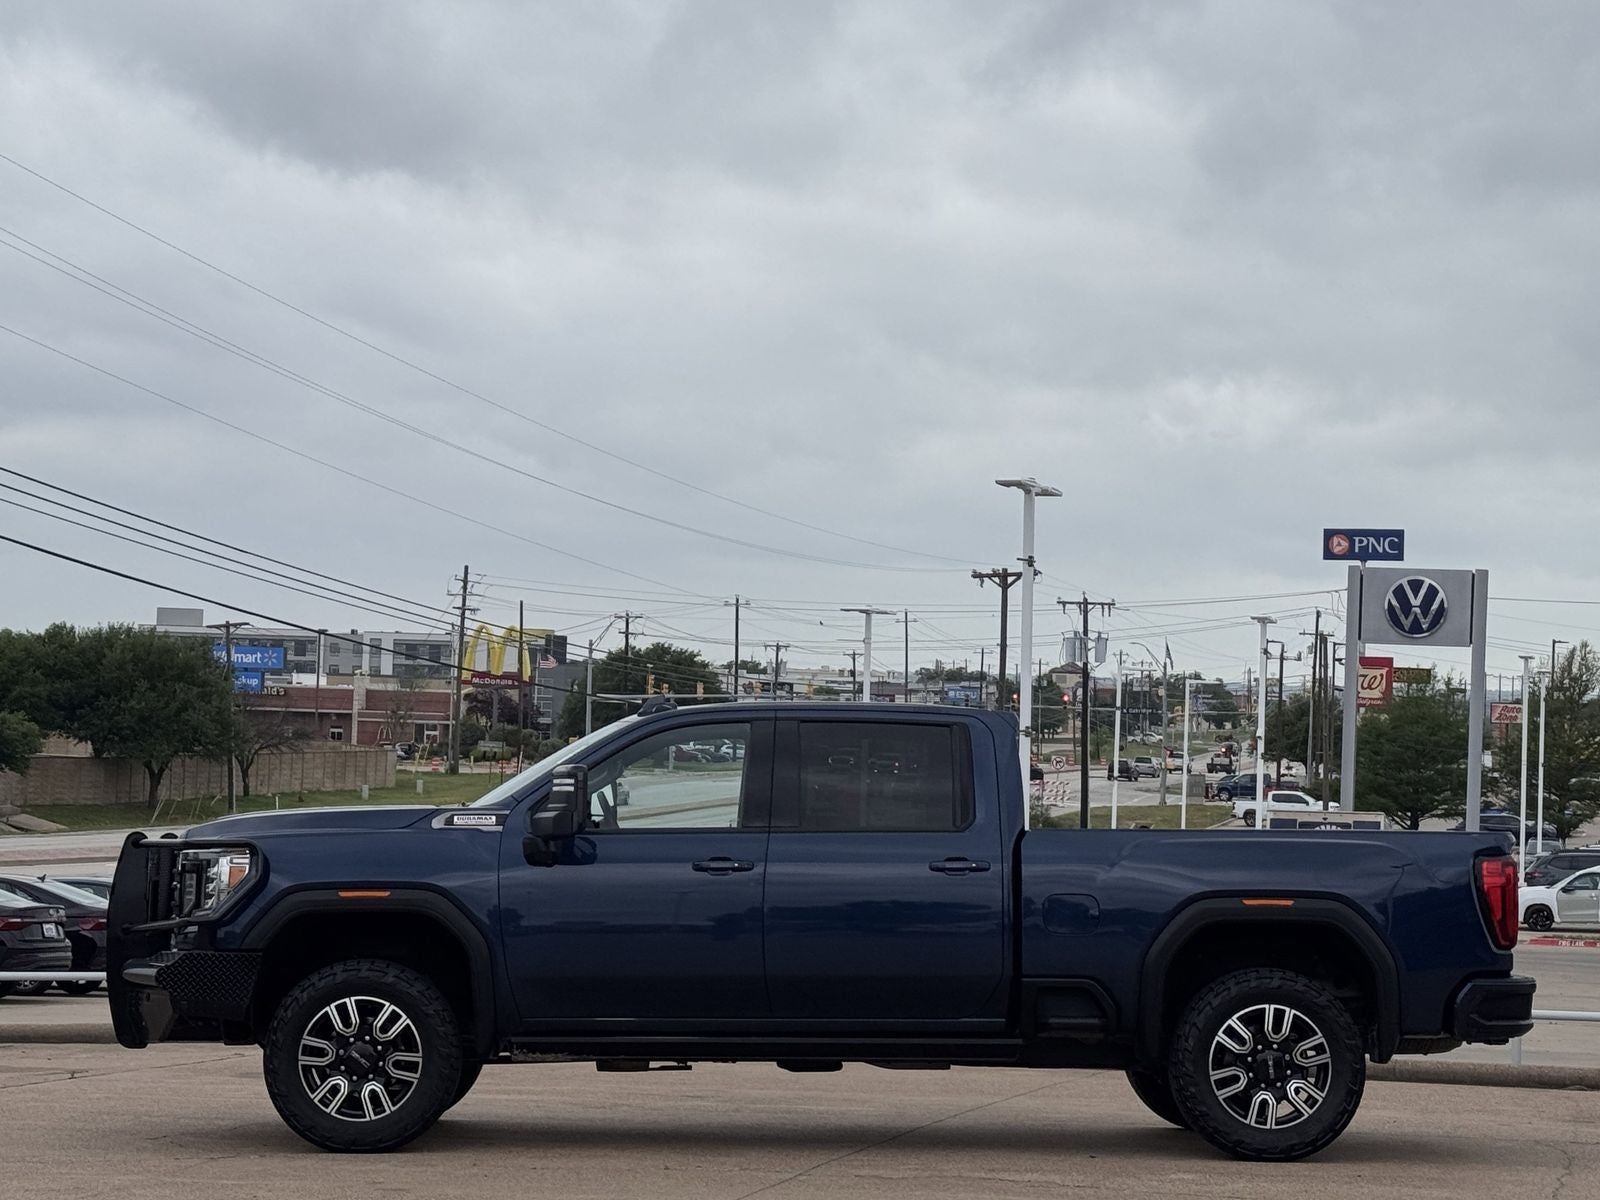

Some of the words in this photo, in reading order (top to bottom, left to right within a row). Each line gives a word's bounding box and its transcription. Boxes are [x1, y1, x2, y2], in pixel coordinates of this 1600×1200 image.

[1353, 537, 1399, 553] PNC
[234, 676, 259, 686] ckup
[1500, 705, 1521, 714] Auto
[1495, 712, 1518, 720] Zone
